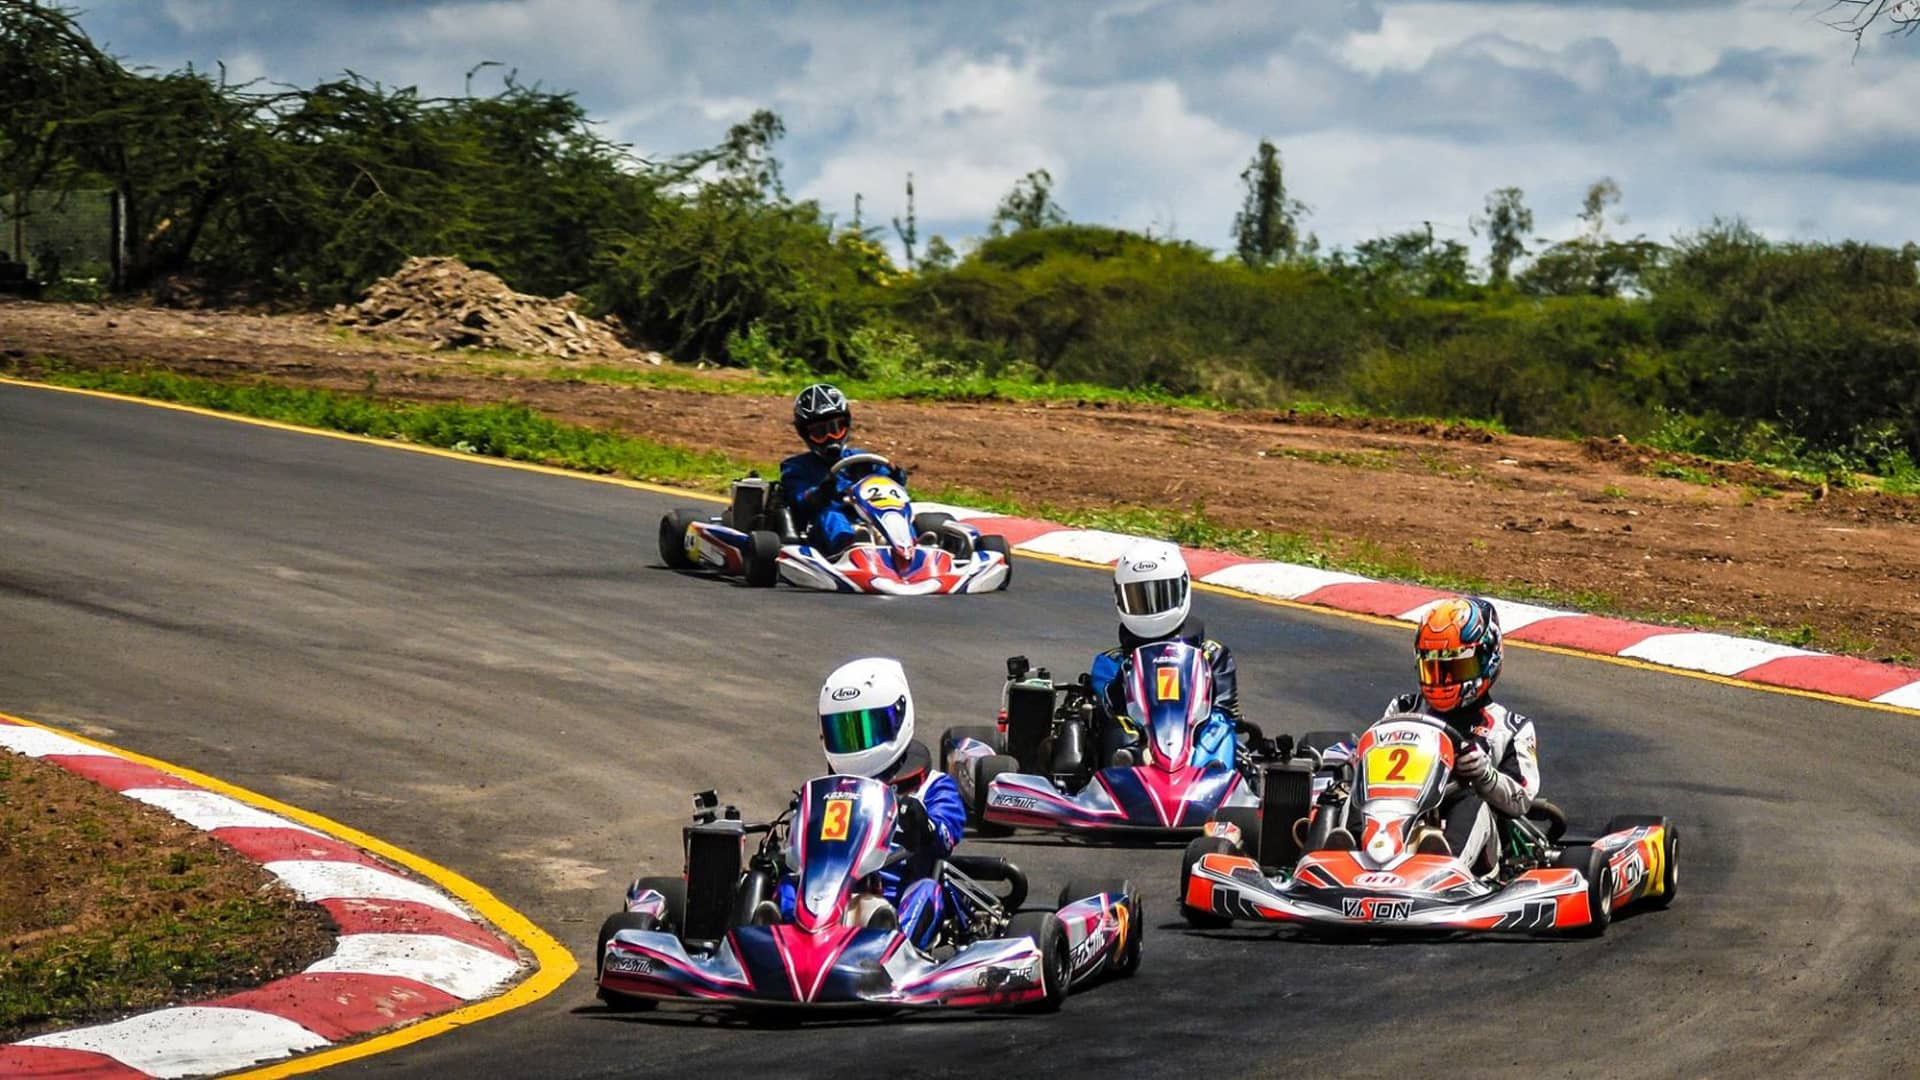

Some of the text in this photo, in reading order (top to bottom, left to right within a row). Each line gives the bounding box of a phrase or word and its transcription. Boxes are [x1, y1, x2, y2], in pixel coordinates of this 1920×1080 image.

[1160, 669, 1177, 698] 7
[1386, 748, 1410, 781] 2
[825, 802, 848, 838] 3
[1343, 897, 1414, 922] VISION
